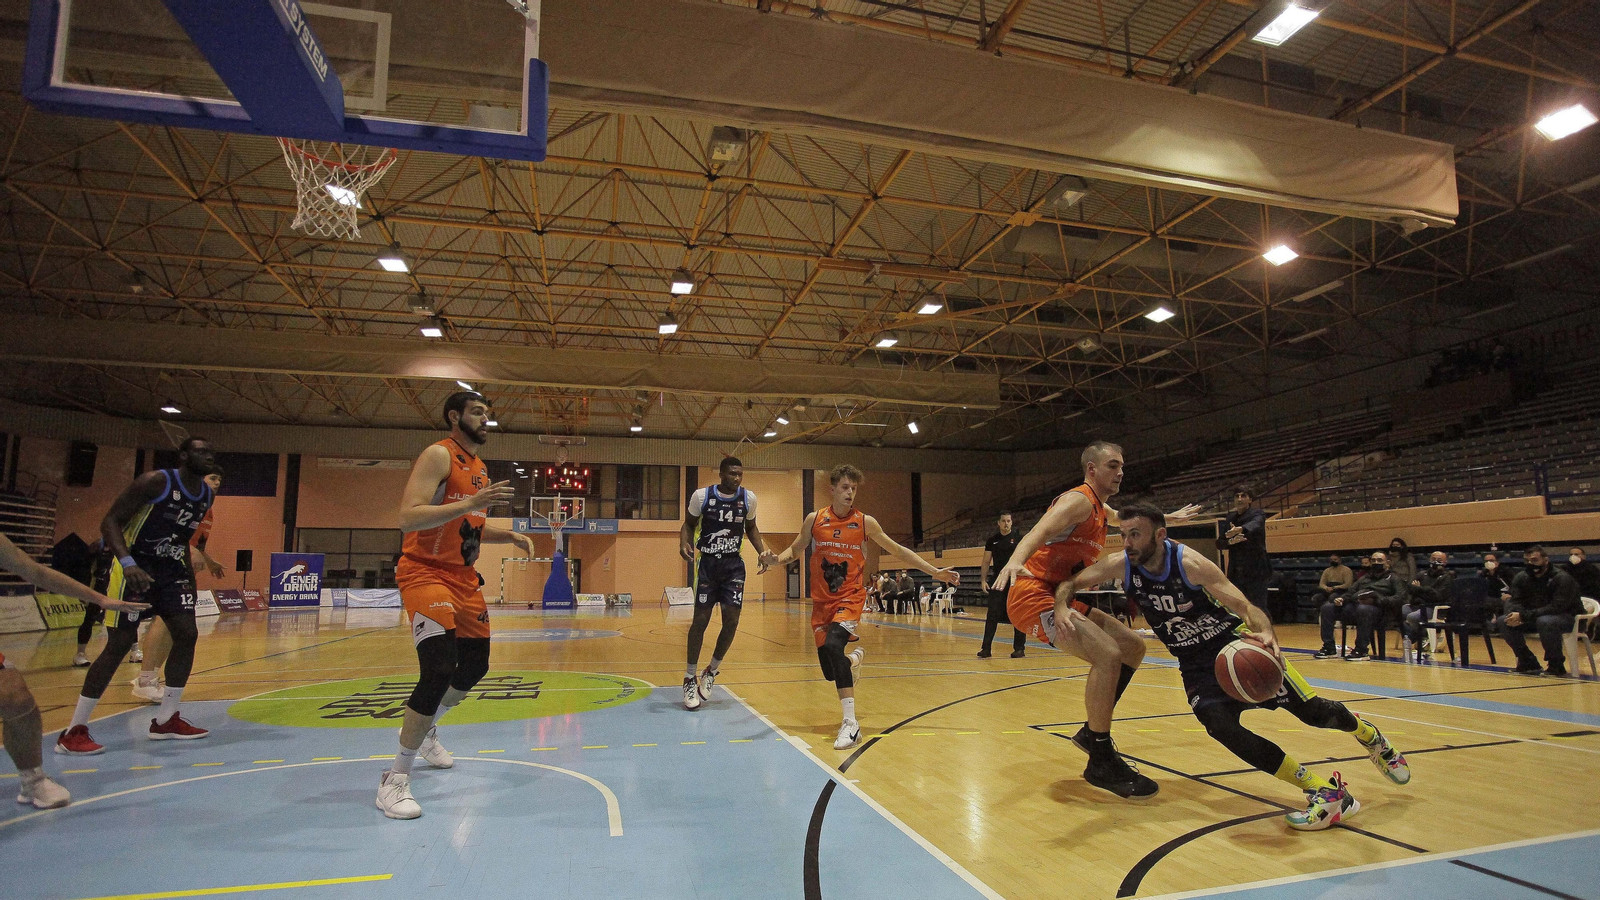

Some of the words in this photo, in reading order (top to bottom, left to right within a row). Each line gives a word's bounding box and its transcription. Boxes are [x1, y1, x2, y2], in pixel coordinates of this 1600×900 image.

[290, 3, 328, 78] SYSTEM
[471, 475, 484, 490] 45
[175, 508, 193, 526] 12
[718, 509, 733, 523] 14
[832, 529, 841, 539] 2
[290, 575, 318, 584] ENER
[284, 583, 318, 592] DRINK
[180, 593, 194, 605] 12
[272, 593, 298, 601] ENERGY
[732, 591, 743, 601] 14
[1148, 593, 1177, 613] 30
[1201, 621, 1232, 641] DRINK
